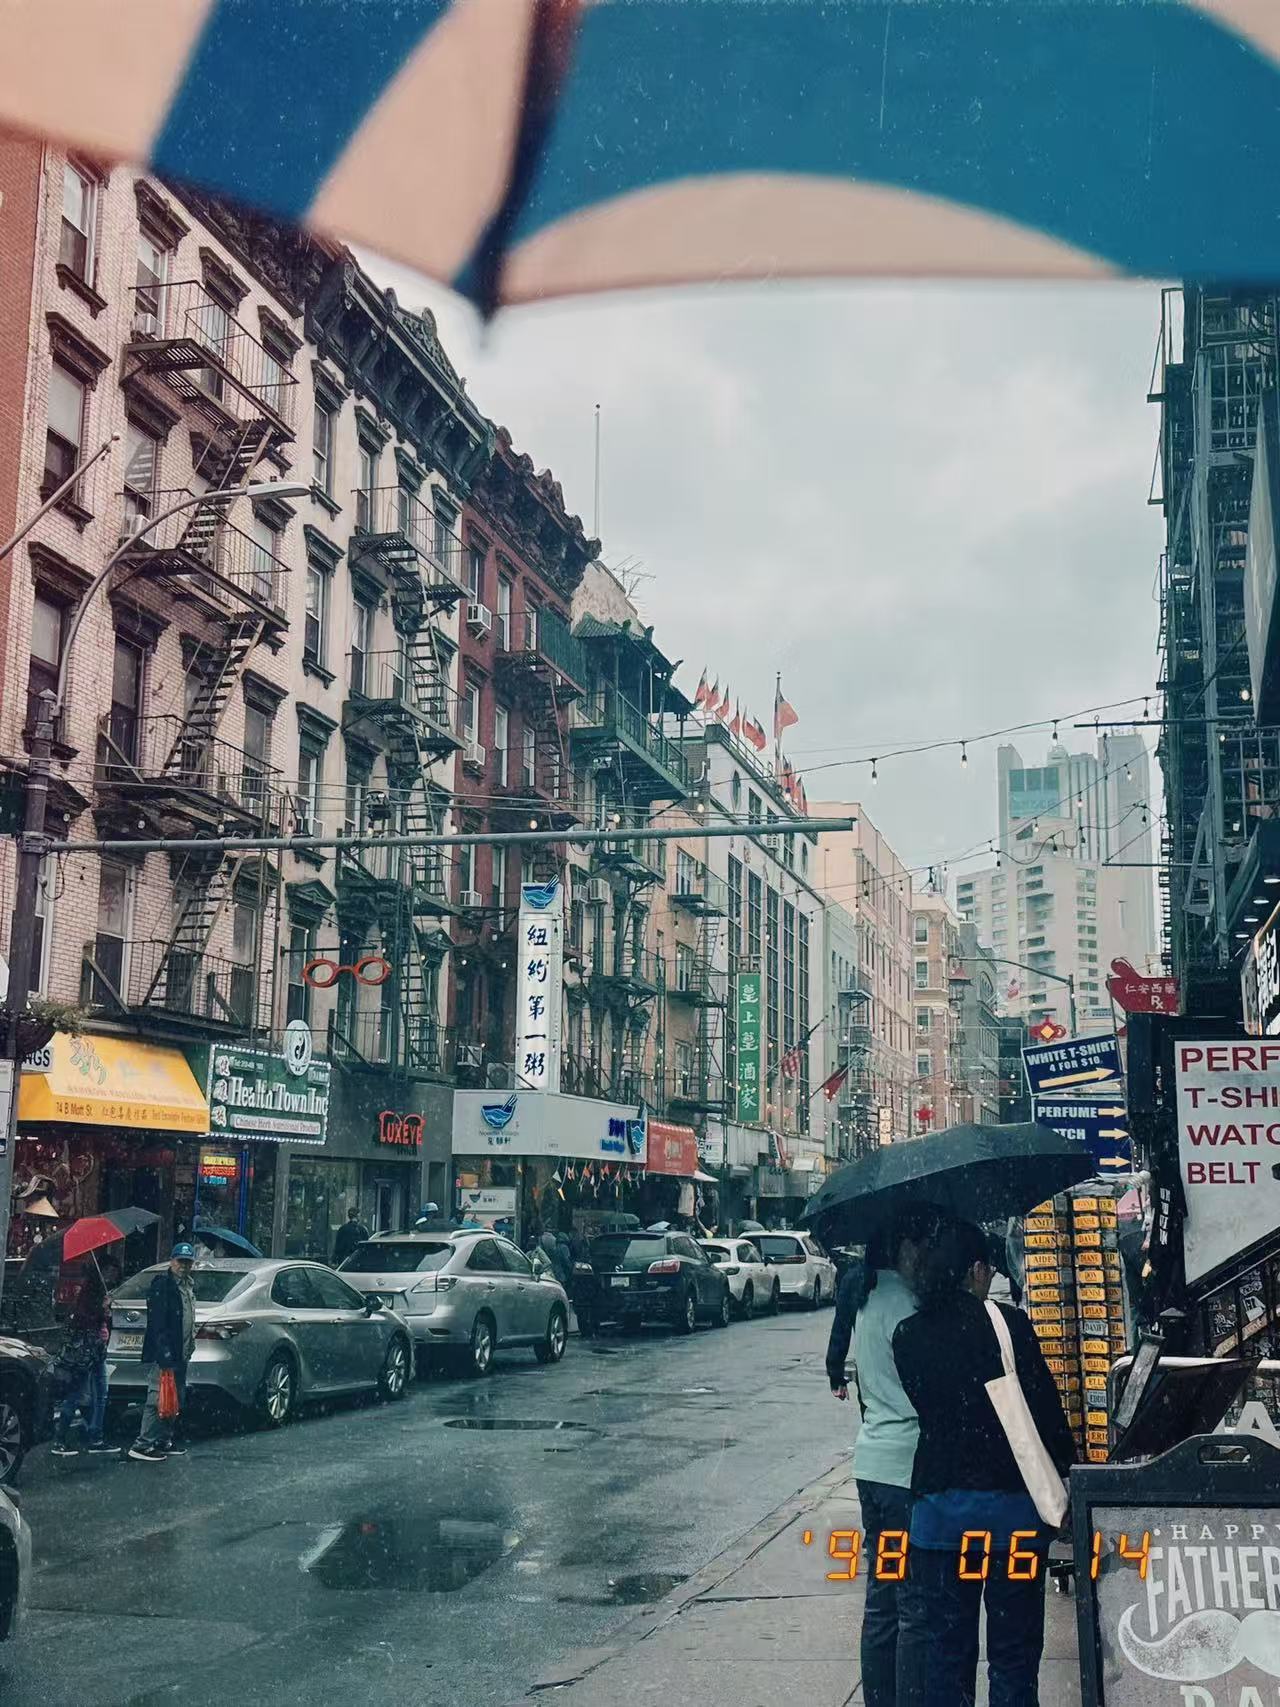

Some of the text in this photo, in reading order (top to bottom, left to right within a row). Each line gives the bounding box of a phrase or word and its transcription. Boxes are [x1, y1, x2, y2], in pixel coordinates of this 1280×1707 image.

[525, 924, 548, 1076] 紐約第一粥
[1026, 1040, 1117, 1066] WHITE T-SHIRT
[1181, 1046, 1280, 1073] PERF
[1049, 1063, 1057, 1072] 4
[1059, 1060, 1079, 1071] FOR
[229, 1075, 274, 1110] Health
[273, 1082, 308, 1113] Town
[308, 1087, 329, 1115] Inc
[1184, 1086, 1278, 1109] T-SHI
[1037, 1106, 1098, 1118] PERFUME
[1187, 1162, 1261, 1184] BELT
